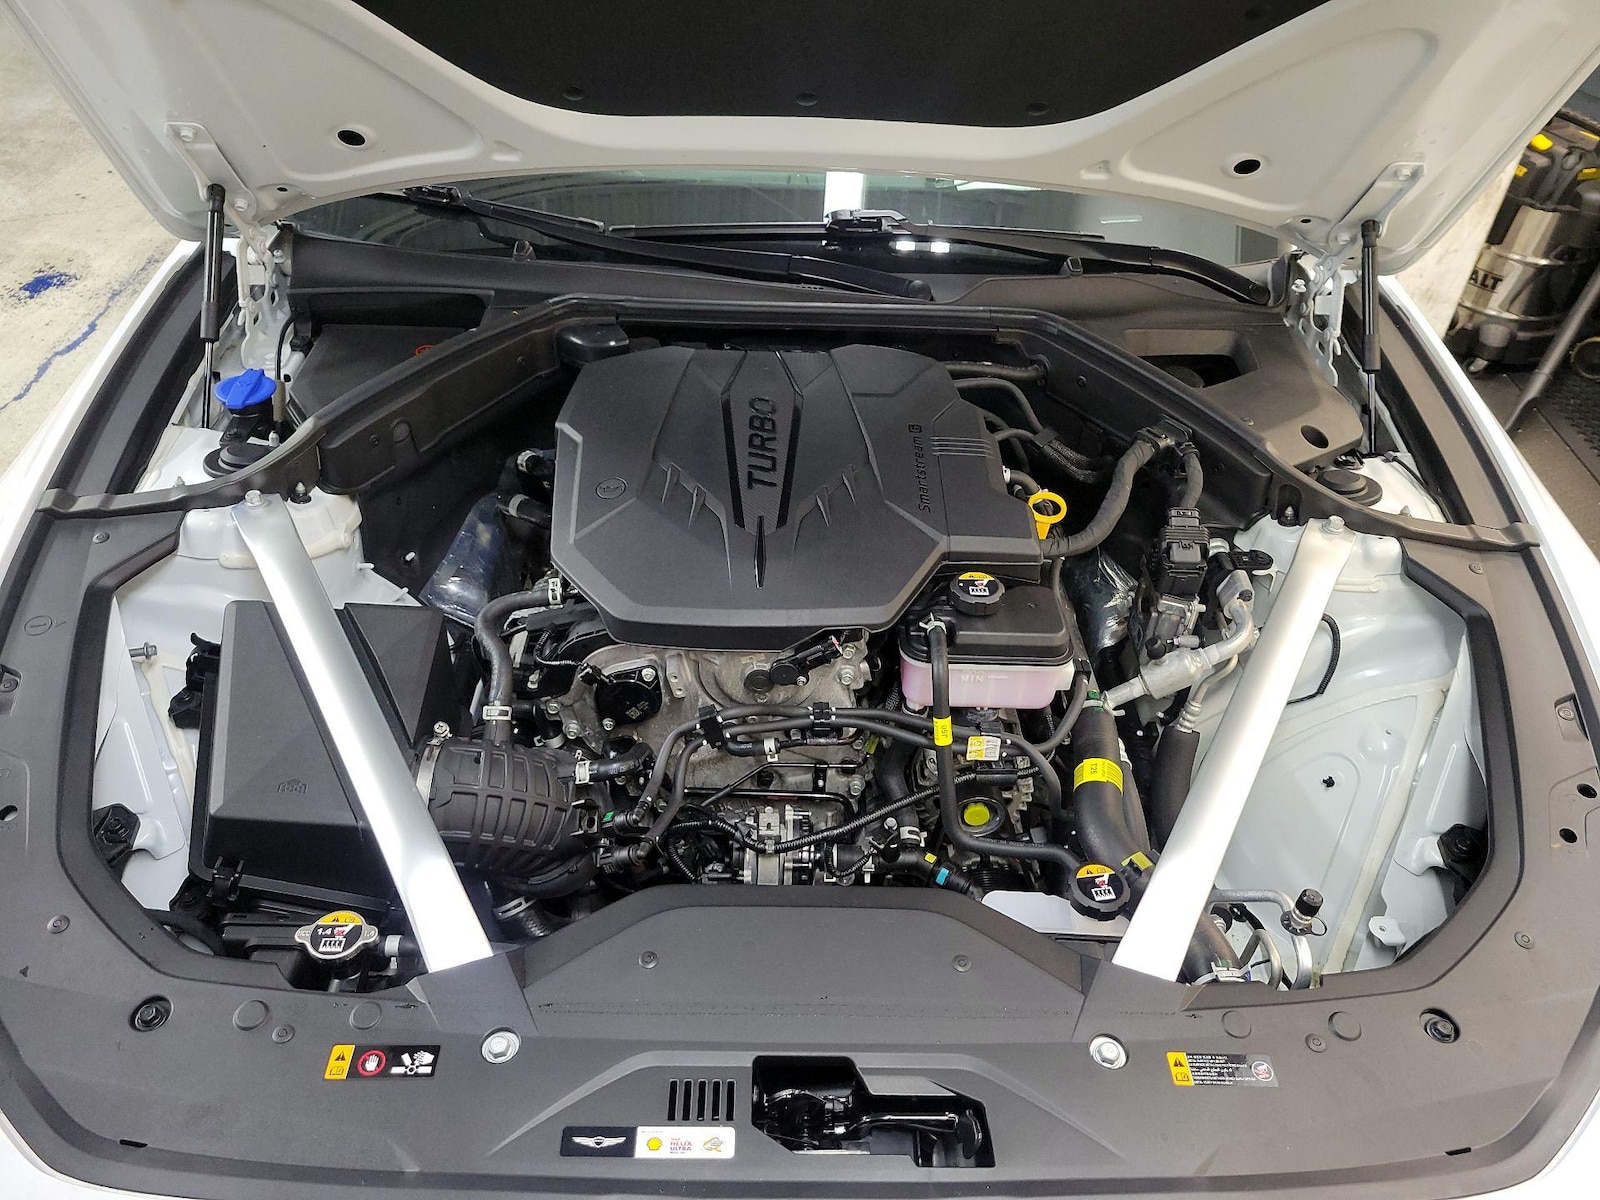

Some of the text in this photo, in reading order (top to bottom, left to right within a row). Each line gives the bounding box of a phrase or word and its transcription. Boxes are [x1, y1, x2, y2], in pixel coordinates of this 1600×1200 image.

[747, 397, 777, 490] TURBO
[908, 424, 931, 513] Smartstream G
[1090, 762, 1098, 775] T25
[317, 927, 333, 936] 1.4
